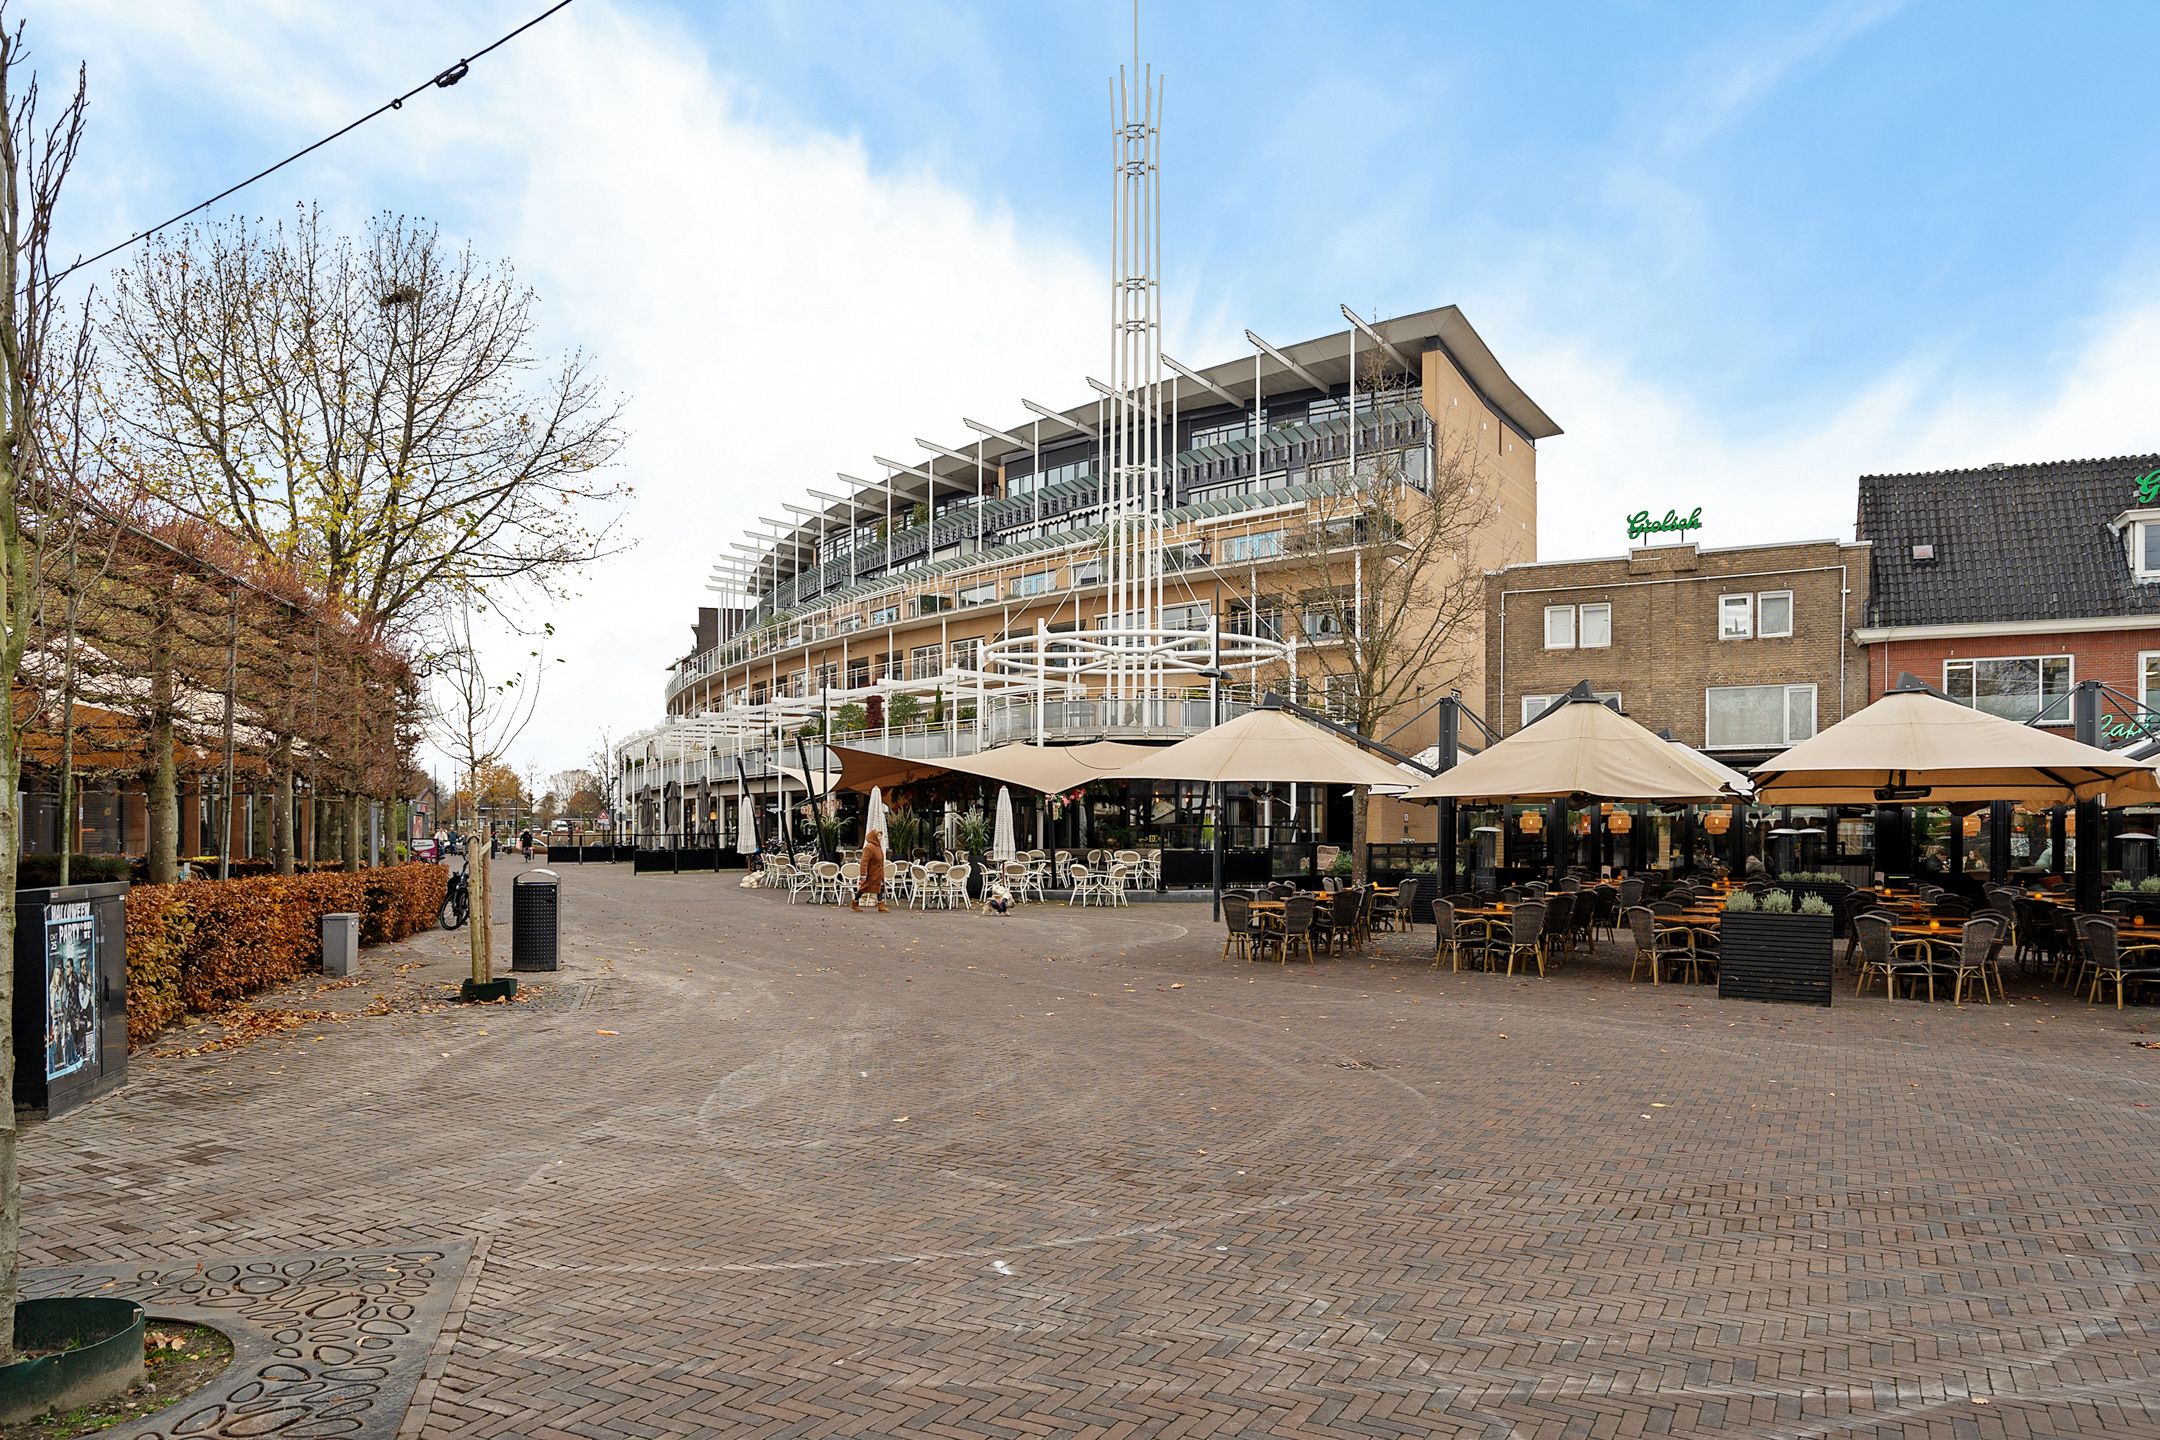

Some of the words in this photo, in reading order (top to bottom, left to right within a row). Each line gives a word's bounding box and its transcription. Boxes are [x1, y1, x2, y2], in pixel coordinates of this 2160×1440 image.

[1627, 507, 1702, 539] Grolsch
[51, 902, 90, 921] HALLOWEEN
[59, 923, 80, 943] PARTY
[50, 941, 57, 950] 25
